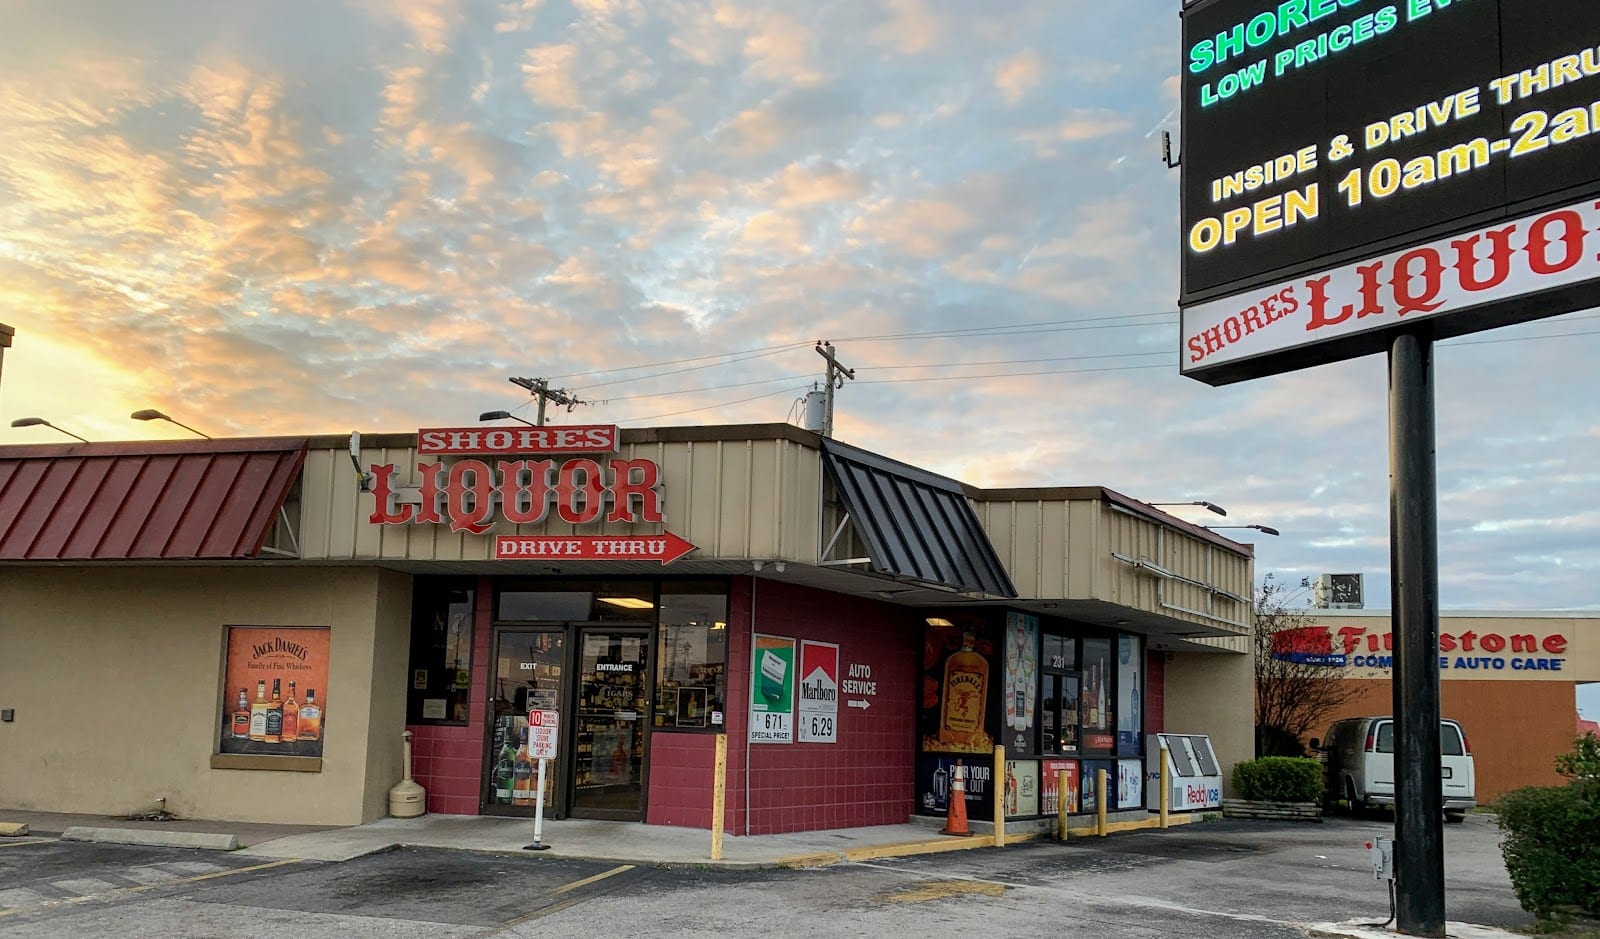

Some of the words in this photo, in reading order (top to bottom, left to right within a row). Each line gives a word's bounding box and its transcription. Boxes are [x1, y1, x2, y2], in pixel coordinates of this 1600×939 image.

[1189, 0, 1361, 73] SHORE
[1201, 59, 1267, 107] LOW
[1275, 5, 1398, 77] PRICES
[1407, 0, 1467, 21] E
[1212, 144, 1318, 202] INSIDE
[1328, 134, 1354, 162] &
[1365, 87, 1481, 151] DRIVE
[1489, 46, 1600, 105] THRU
[1189, 183, 1319, 254] OPEN
[1338, 101, 1600, 208] 10am-2a
[1187, 286, 1299, 364] SHORES
[1305, 201, 1600, 332] LIQUO
[421, 428, 612, 451] SHORES
[368, 457, 665, 535] LIQUOR
[500, 540, 582, 556] DRIVE
[592, 540, 667, 555] THRU
[252, 641, 274, 660] JACK
[520, 662, 537, 670] EXIT
[596, 663, 633, 672] ENTRANCE
[1053, 655, 1065, 669] 231
[1354, 655, 1448, 669] COME
[1454, 656, 1505, 670] AUTO
[1511, 657, 1562, 671] CARE
[849, 663, 871, 679] AUTO
[802, 679, 836, 701] Marlboro
[842, 680, 877, 696] SERVICE
[531, 711, 541, 725] 10
[812, 716, 833, 737] 6.29
[751, 731, 772, 739] SPECIAL
[970, 766, 990, 780] YOUR
[970, 779, 985, 793] OUT
